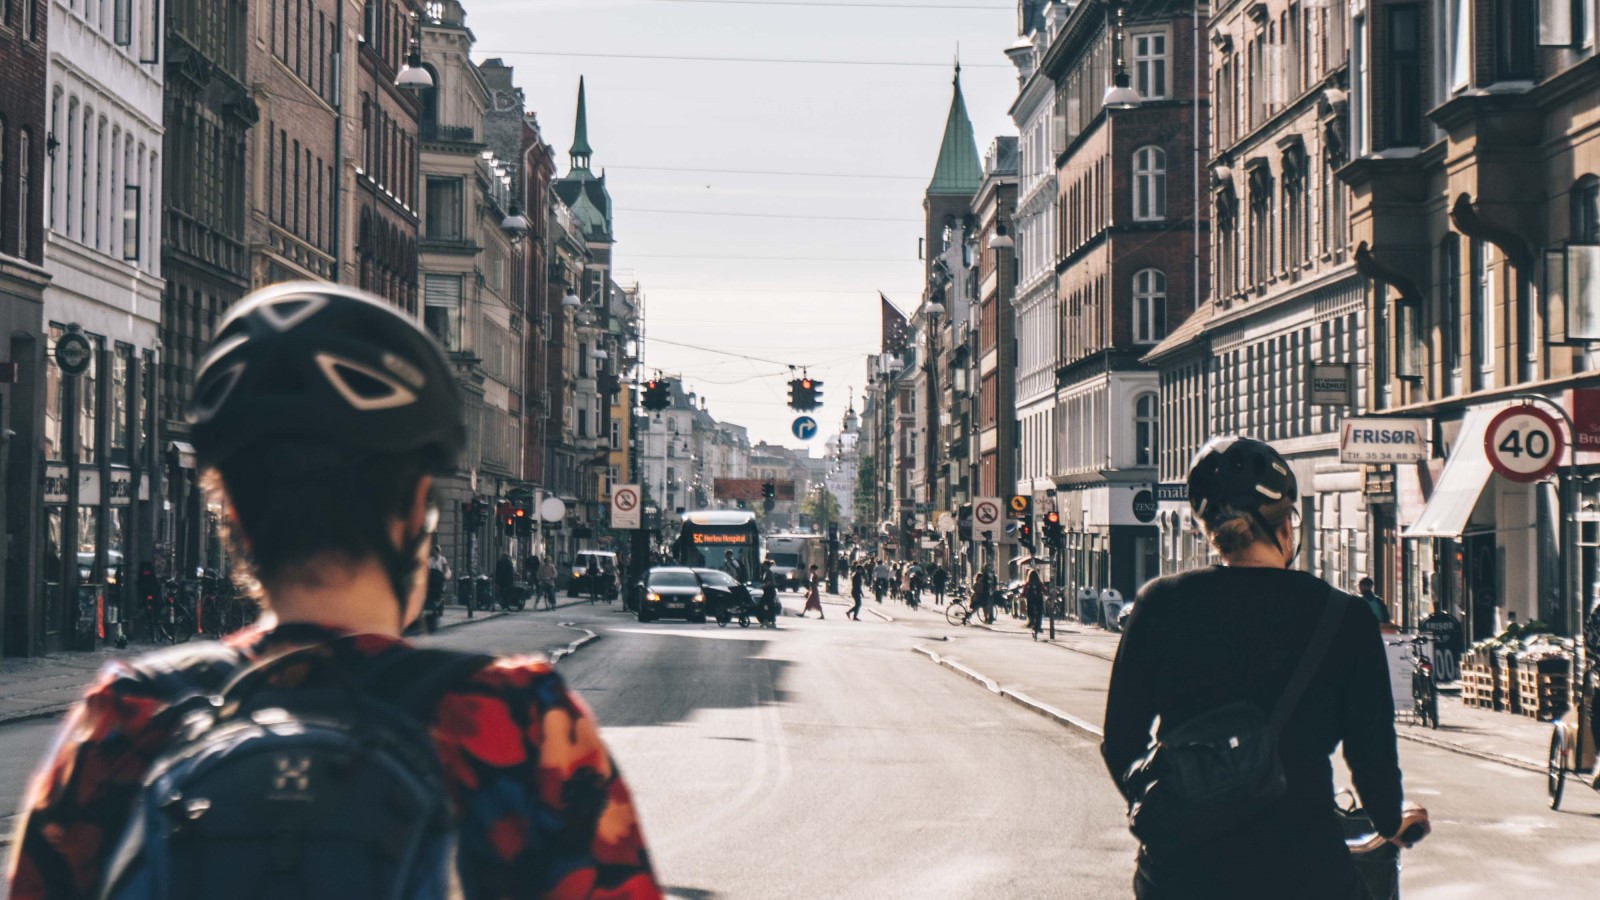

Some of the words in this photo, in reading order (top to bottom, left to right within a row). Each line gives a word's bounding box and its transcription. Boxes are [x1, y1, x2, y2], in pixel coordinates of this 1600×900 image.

[1353, 429, 1416, 444] FRISØR
[1499, 430, 1549, 459] 40
[1135, 503, 1157, 511] ZENZ
[693, 533, 703, 543] 5C
[723, 534, 746, 543] Hospital
